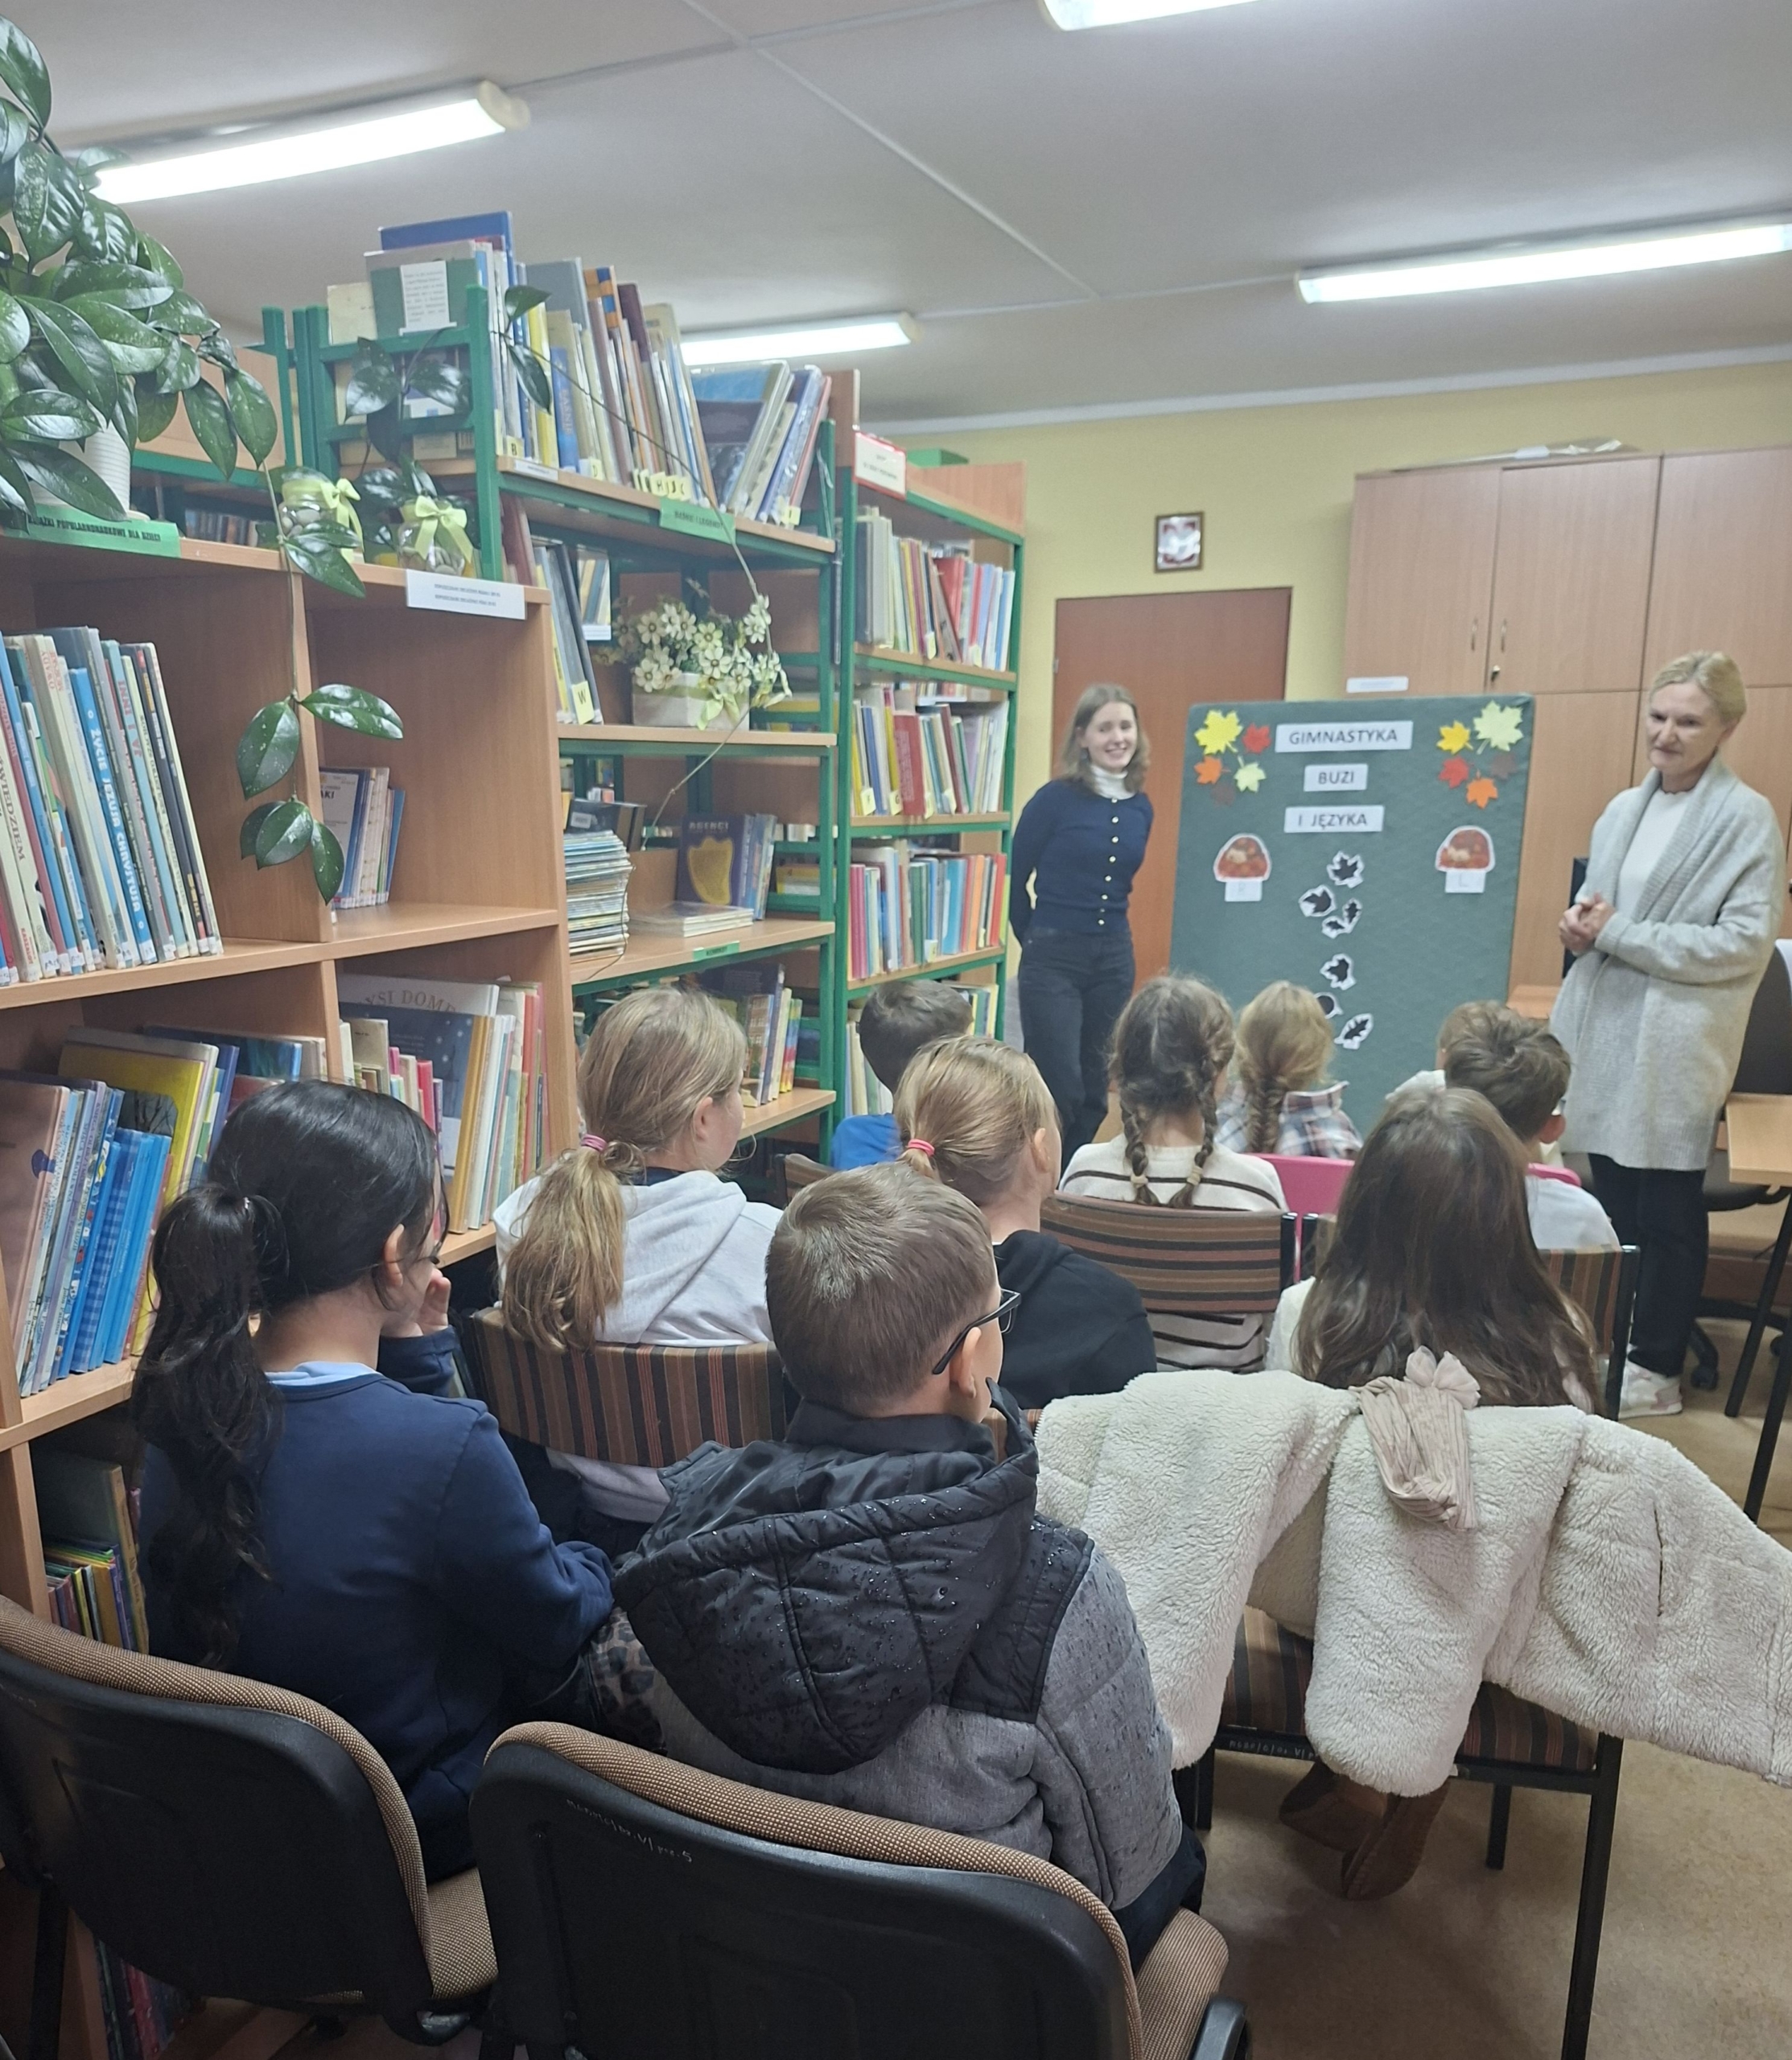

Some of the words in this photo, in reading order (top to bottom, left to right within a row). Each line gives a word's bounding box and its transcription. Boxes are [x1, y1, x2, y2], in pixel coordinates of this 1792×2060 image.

[128, 529, 140, 540] DLA
[1289, 728, 1399, 745] GIMNASTYKA
[1317, 770, 1355, 785] BUZI
[0, 756, 26, 861] WIEDZIEM
[90, 727, 108, 772] ŻYCIE
[102, 777, 122, 828] JEZUSA
[116, 832, 141, 913] CHRYSTUSA
[1298, 814, 1303, 826] I
[1310, 813, 1368, 830] JĘZYKA
[20, 928, 34, 965] KASZALOT
